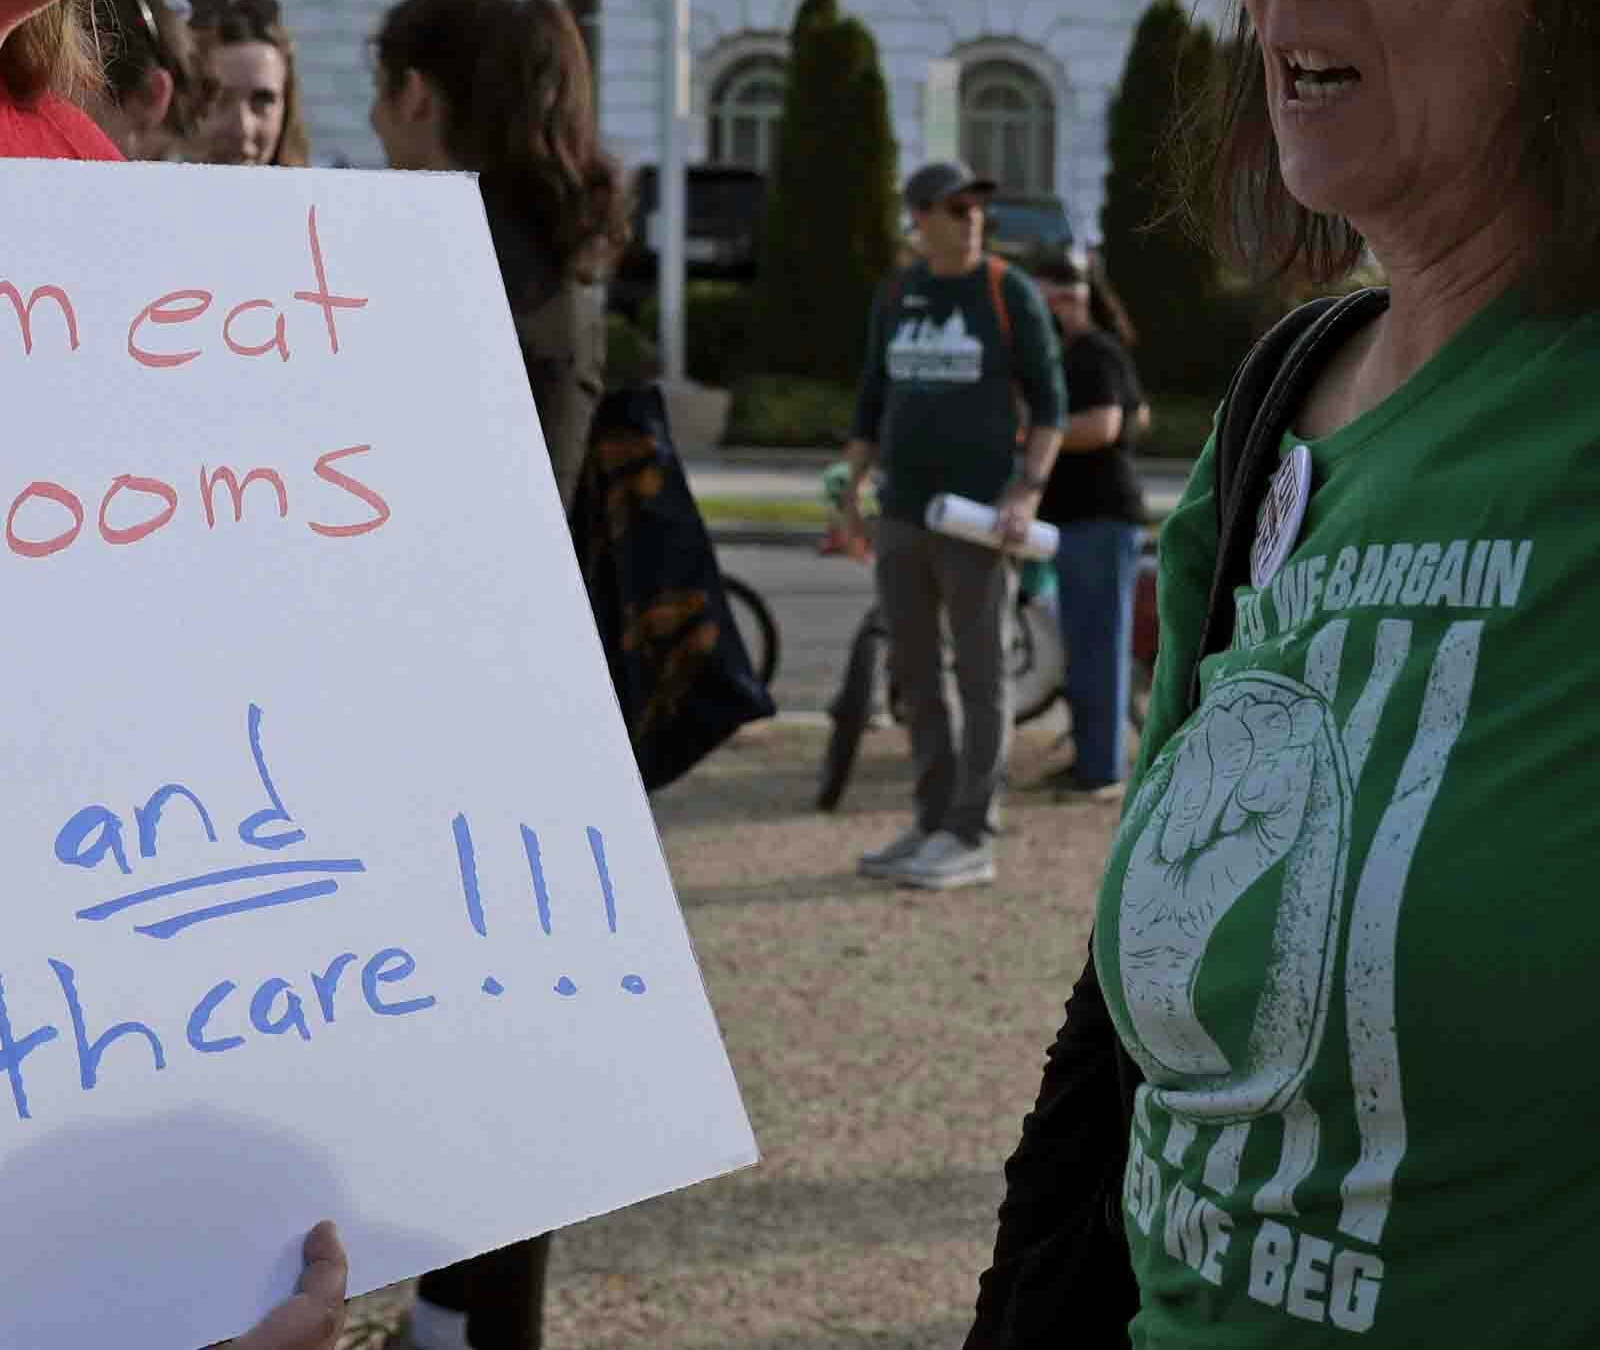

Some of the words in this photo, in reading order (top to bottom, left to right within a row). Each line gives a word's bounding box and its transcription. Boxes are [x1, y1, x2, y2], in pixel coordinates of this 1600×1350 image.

[128, 204, 369, 368] eat
[1321, 539, 1533, 611] BARGAIN
[54, 703, 306, 874] and
[450, 811, 648, 996] !!!
[1248, 1217, 1385, 1334] BEG
